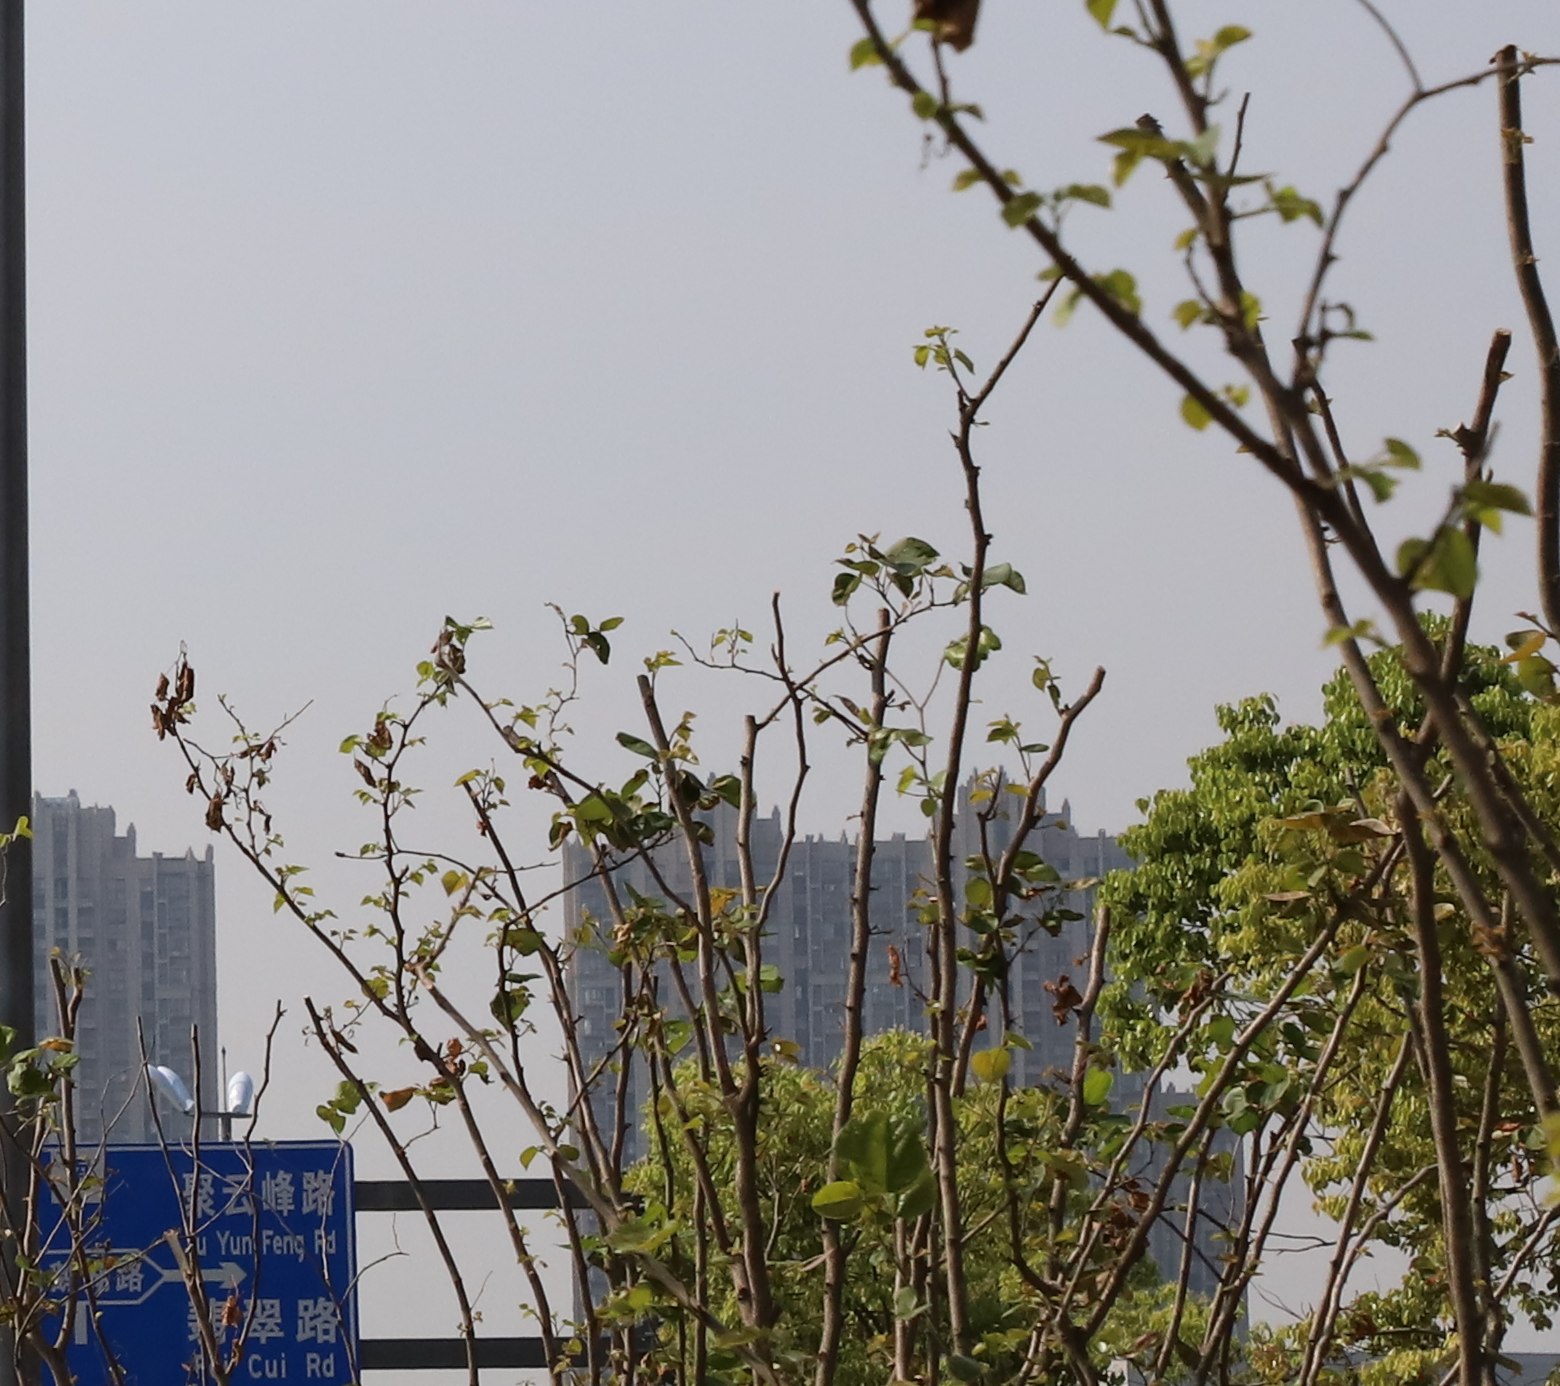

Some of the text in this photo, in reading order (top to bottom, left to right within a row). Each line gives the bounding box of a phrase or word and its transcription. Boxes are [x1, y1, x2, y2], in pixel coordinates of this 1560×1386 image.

[182, 1169, 335, 1218] 聚云峰路
[216, 1230, 252, 1255] Yun
[262, 1229, 304, 1262] Feng
[314, 1229, 336, 1255] Rd
[248, 1353, 287, 1379] Cui
[306, 1352, 335, 1378] Rd
